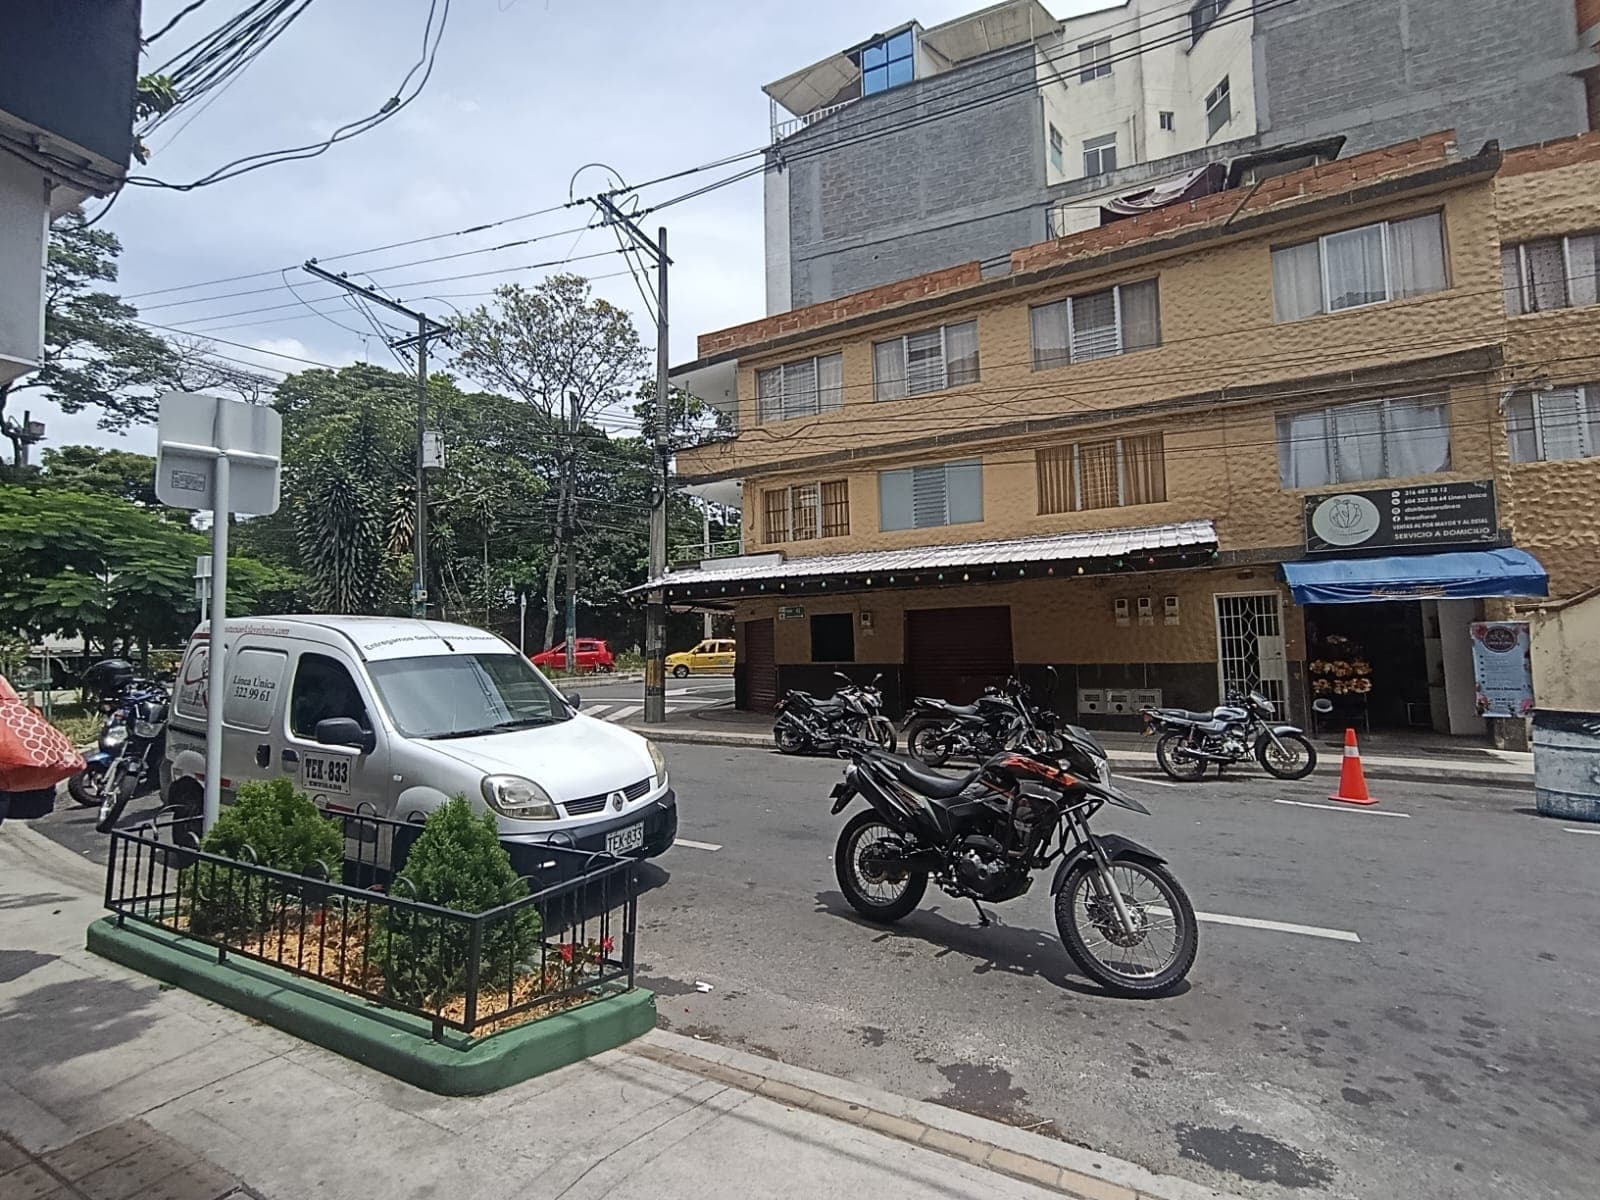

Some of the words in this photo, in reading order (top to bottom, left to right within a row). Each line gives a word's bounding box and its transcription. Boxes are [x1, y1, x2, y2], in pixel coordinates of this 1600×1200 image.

[1394, 531, 1433, 540] SERVICIO
[1443, 527, 1490, 537] DOMICILIO
[234, 686, 247, 698] 322
[248, 688, 259, 700] 99
[260, 690, 271, 702] 61
